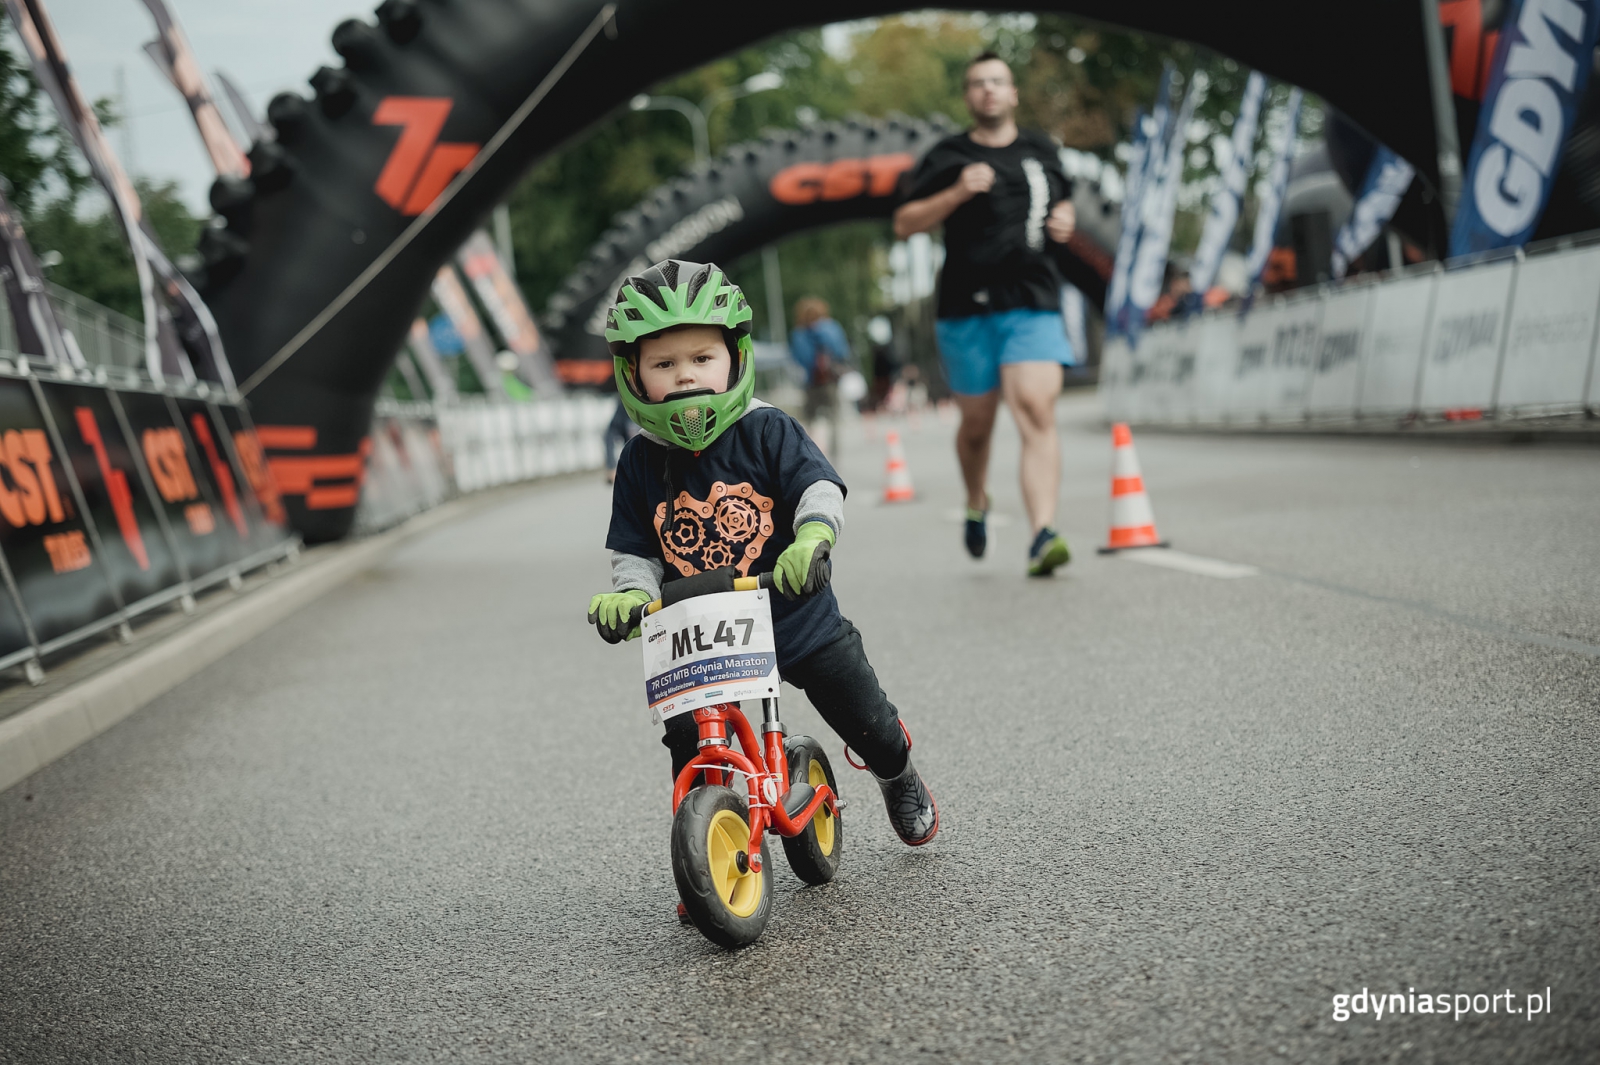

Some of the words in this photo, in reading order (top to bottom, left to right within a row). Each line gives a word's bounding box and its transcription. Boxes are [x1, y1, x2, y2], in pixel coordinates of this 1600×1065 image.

[671, 617, 755, 661] MŁ47
[651, 679, 660, 691] 7R
[660, 673, 673, 687] CST
[673, 667, 690, 682] MTB
[690, 660, 723, 676] Gdynia
[724, 657, 768, 669] Maraton
[703, 675, 709, 683] 8
[709, 670, 740, 682] września
[741, 669, 760, 677] 2018
